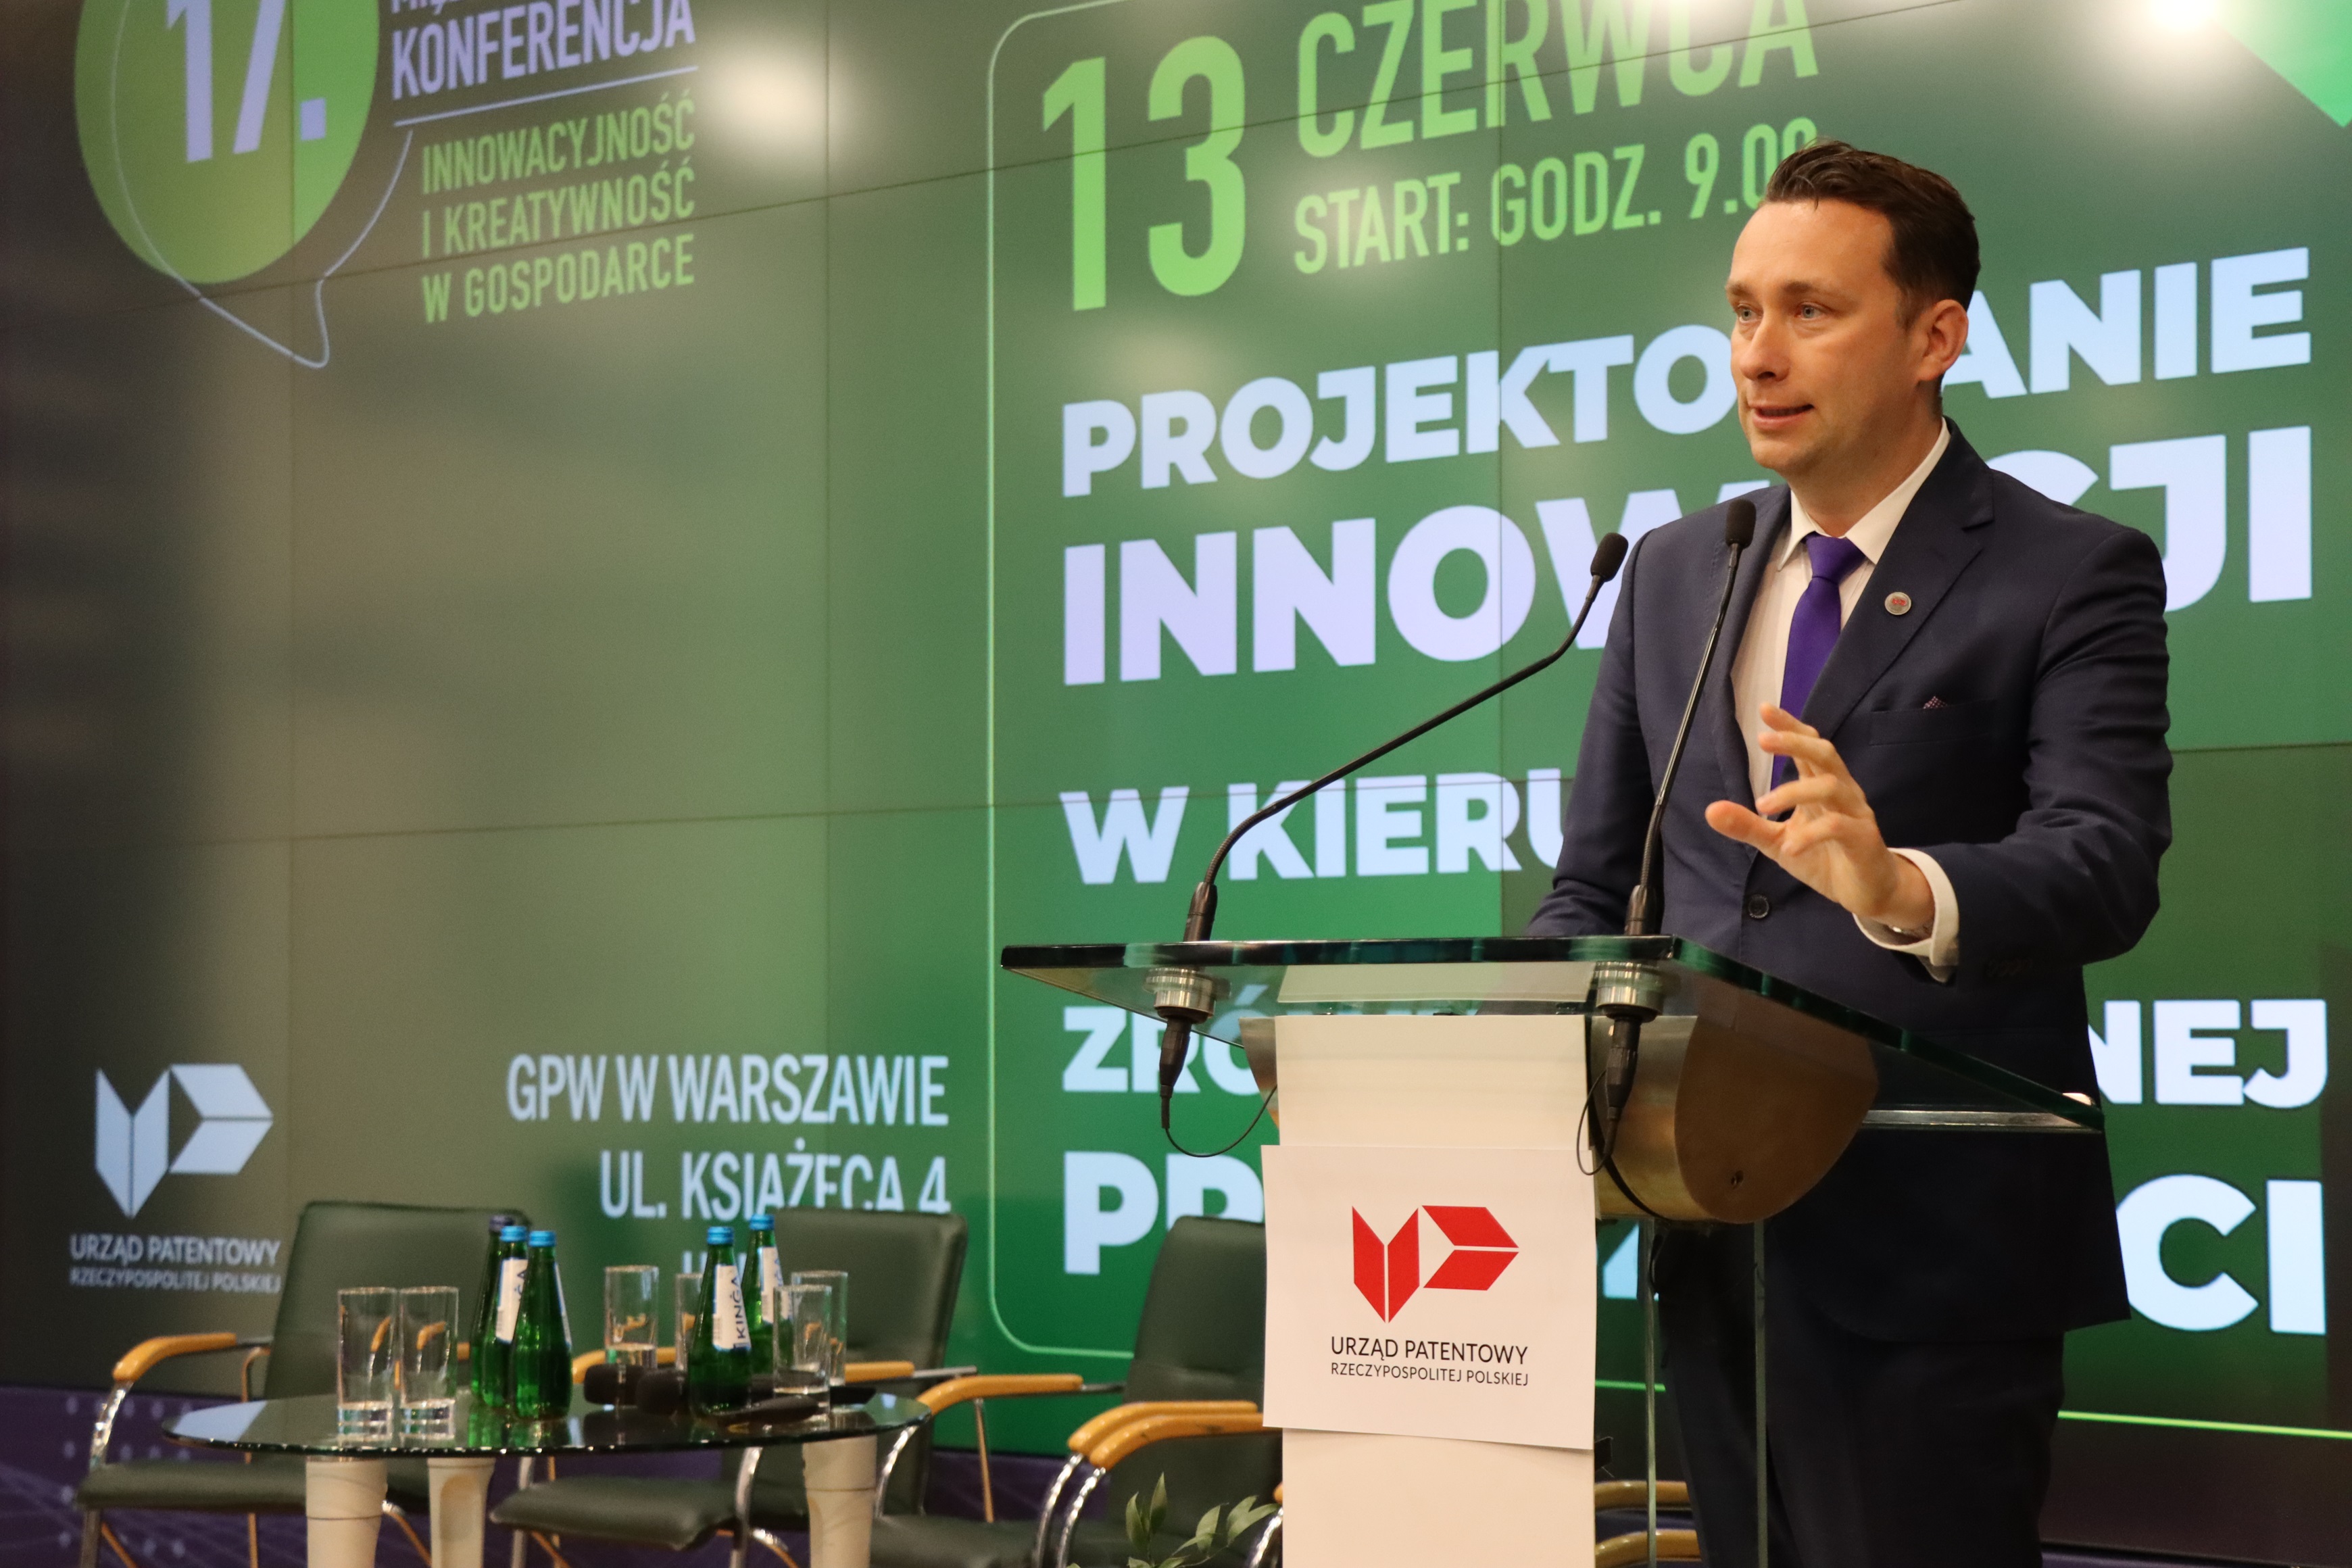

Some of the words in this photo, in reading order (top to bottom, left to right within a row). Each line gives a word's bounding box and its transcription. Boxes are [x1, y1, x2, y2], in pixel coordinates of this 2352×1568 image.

[392, 0, 695, 101] KONFERENCJA
[1298, 0, 1819, 158] CZERWCA
[422, 89, 695, 195] INNOWACYJNOŚĆ
[1043, 35, 1246, 311] 13
[422, 210, 431, 259] I
[444, 156, 695, 255] KREATYWNOŚĆ
[1294, 172, 1469, 274] START:
[1492, 144, 1661, 247] GODZ.
[422, 272, 451, 324] W
[464, 232, 695, 318] GOSPODARCE
[1063, 247, 2311, 497] PROJEKTOANIE
[1059, 785, 1190, 885] W
[506, 1052, 607, 1122] GPW
[616, 1054, 660, 1123] W
[668, 1054, 949, 1126] WARSZAWIE
[600, 1150, 666, 1219] UL.
[918, 1156, 952, 1215] 4
[70, 1233, 144, 1267] URZĄD
[147, 1235, 282, 1267] PATENTOWY
[1331, 1336, 1398, 1361] URZĄD
[1405, 1340, 1528, 1365] PATENTOWY
[1331, 1363, 1463, 1383] RZECZYPOSPOLITEJ
[1467, 1370, 1529, 1387] POLSKIEJ
